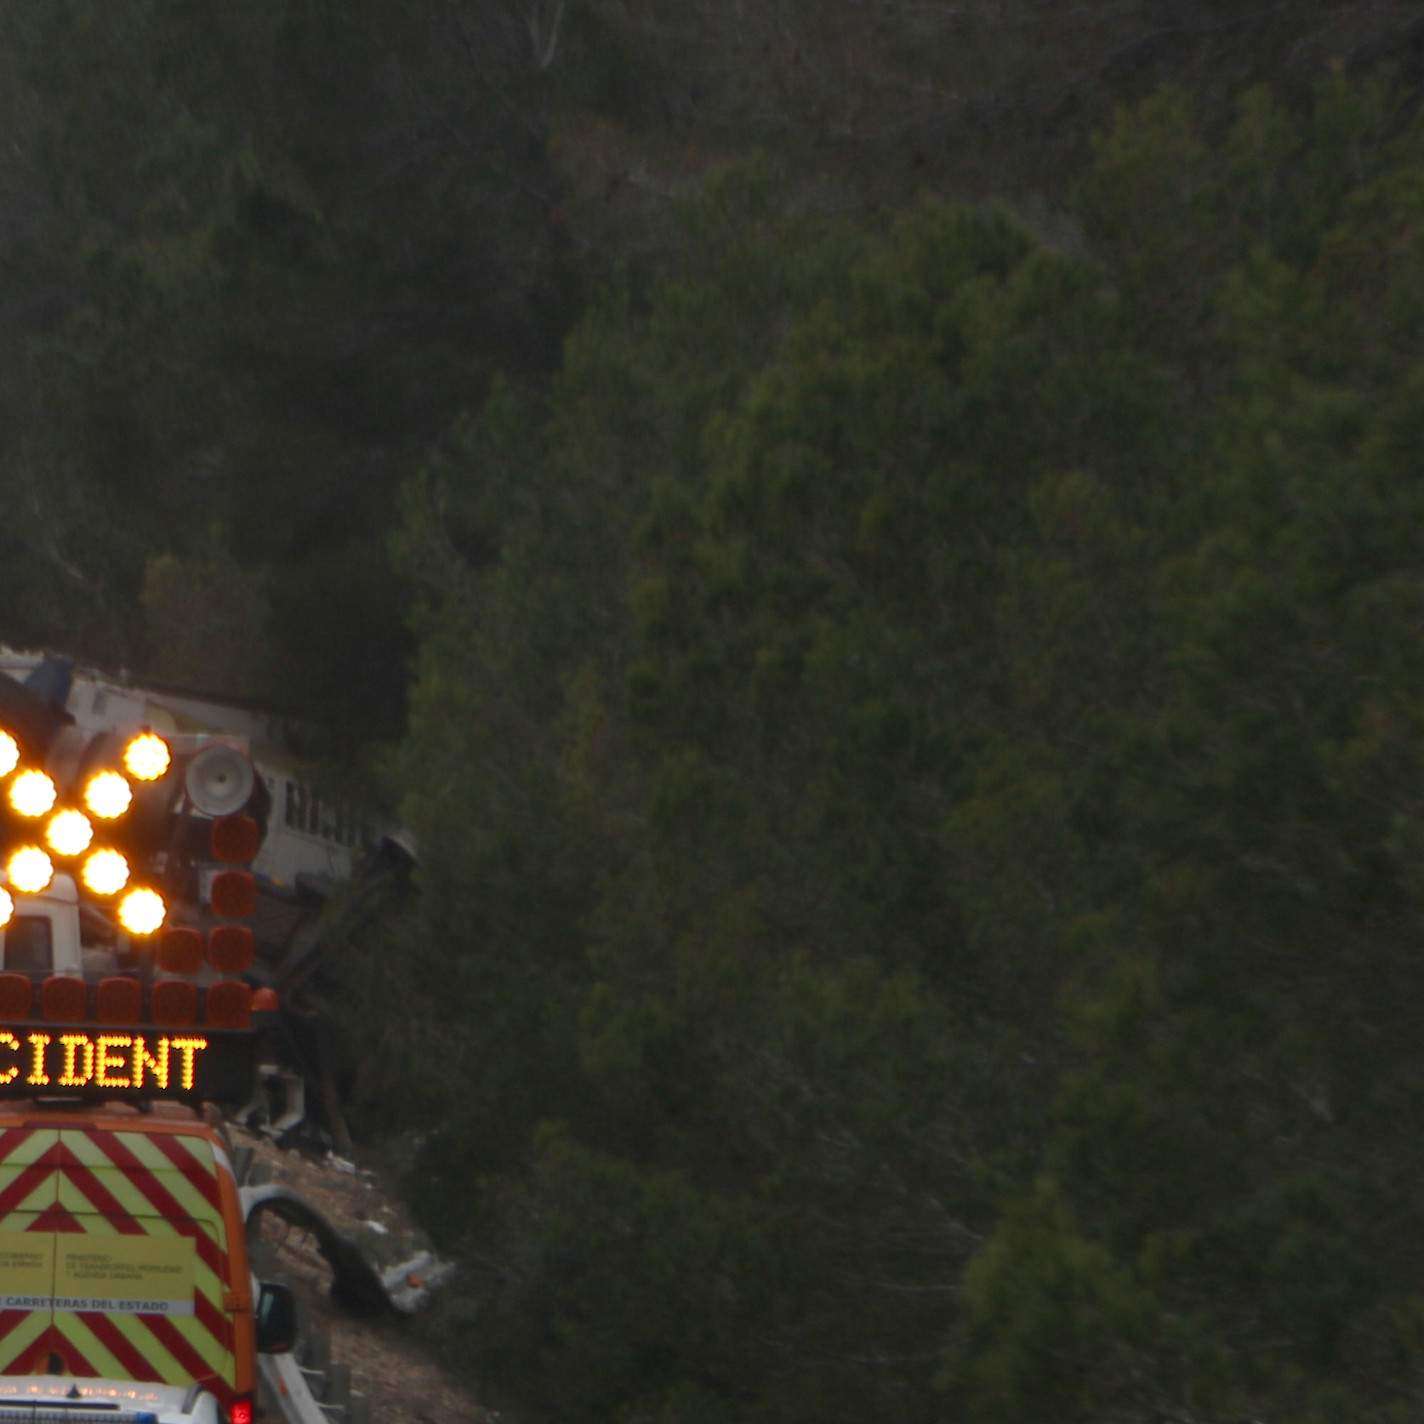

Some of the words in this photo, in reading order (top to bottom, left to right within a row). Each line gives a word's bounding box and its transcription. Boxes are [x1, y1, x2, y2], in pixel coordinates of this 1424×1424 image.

[6, 1297, 87, 1309] CARRETERAS
[92, 1299, 112, 1310] DEL
[119, 1300, 168, 1311] ESTADO
